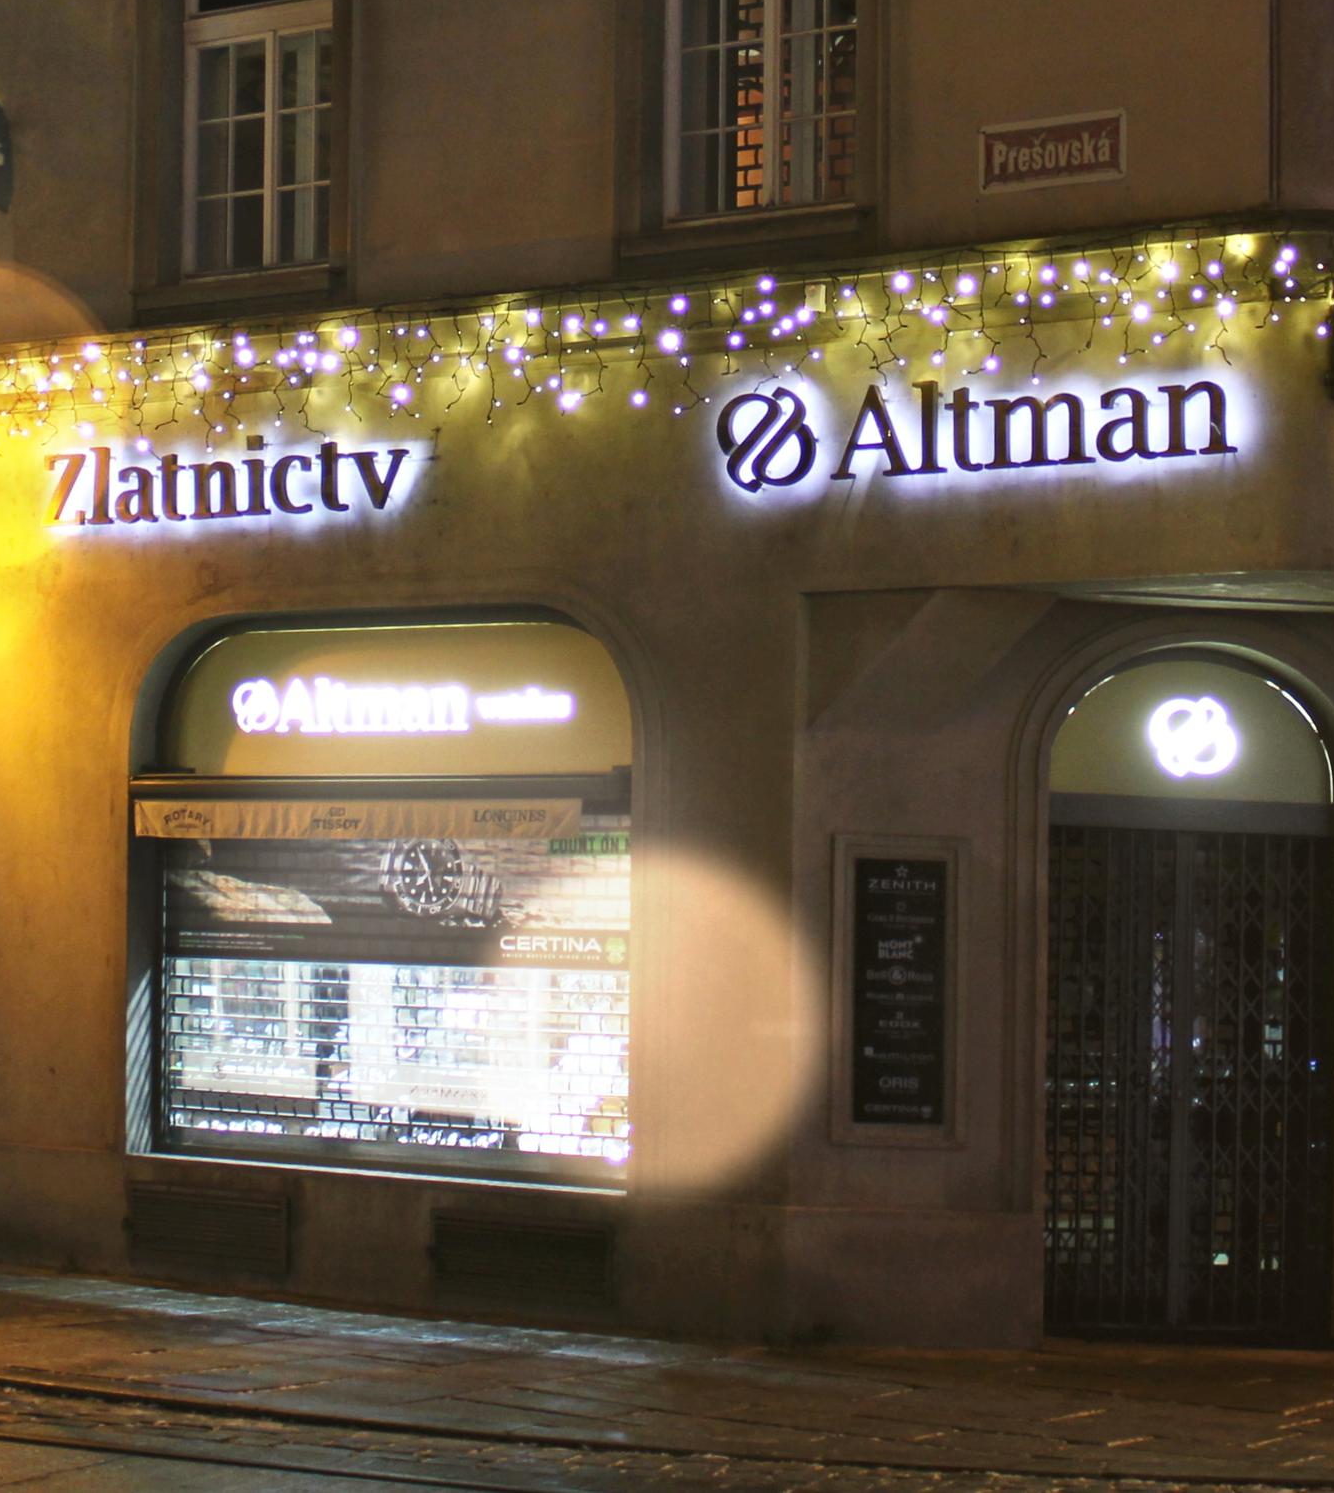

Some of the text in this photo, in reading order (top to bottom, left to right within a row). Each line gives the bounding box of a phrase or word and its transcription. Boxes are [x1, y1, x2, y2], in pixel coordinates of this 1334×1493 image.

[992, 131, 1111, 175] Prešovská
[830, 379, 1237, 480] Altman
[42, 436, 410, 526] Zlatnictv
[313, 818, 362, 831] TISSOT
[474, 808, 547, 824] LONGINES
[868, 878, 936, 891] ZENITH
[500, 935, 603, 953] CERTINA
